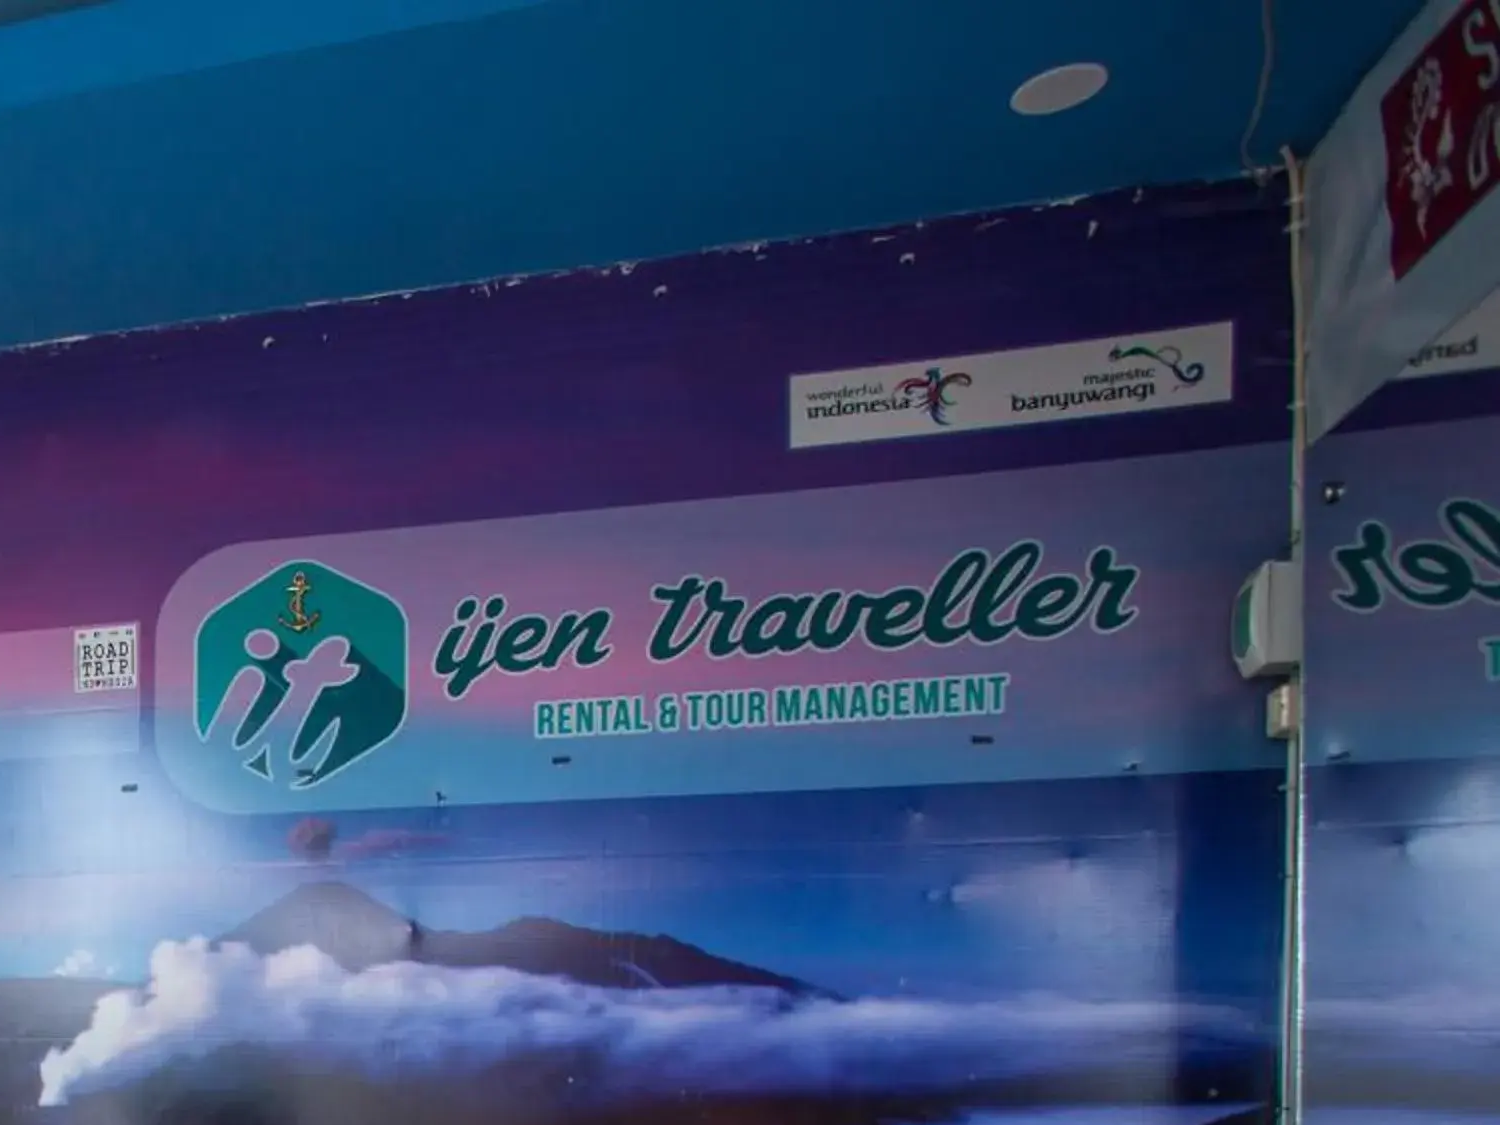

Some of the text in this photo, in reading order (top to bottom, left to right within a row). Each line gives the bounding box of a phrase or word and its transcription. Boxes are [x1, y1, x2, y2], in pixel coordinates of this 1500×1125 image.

[1083, 367, 1156, 386] majestic
[805, 382, 884, 402] wonderful
[1011, 381, 1156, 412] banyuwangi
[806, 396, 910, 419] indonesia
[433, 539, 1141, 700] ijen traveller
[82, 640, 129, 660] ROAD
[82, 659, 129, 677] TRIP
[535, 673, 1008, 739] RENTAL & TOUR MANAGEMENT
